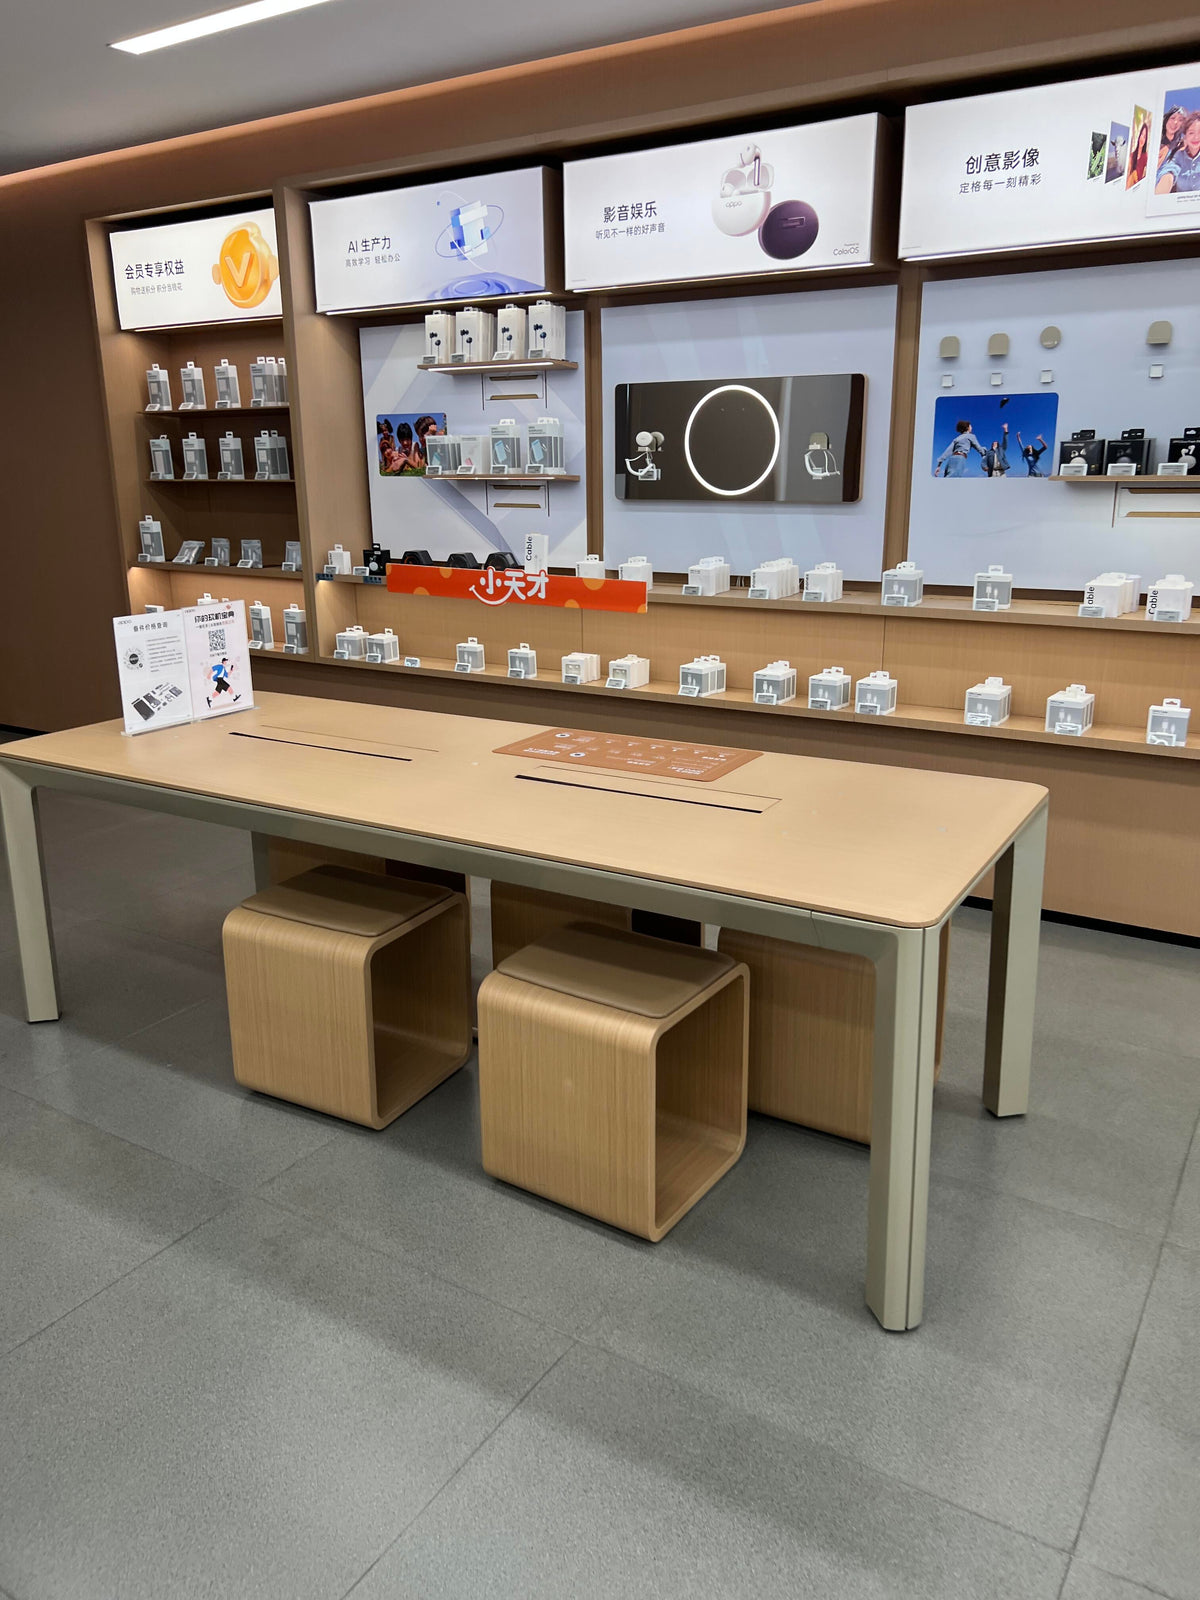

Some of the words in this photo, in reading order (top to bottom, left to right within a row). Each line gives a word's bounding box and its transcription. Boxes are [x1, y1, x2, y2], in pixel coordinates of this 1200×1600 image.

[965, 147, 1040, 175] 创意影像
[958, 173, 1042, 194] 定格每一刻精彩
[603, 200, 657, 223] 影音娱乐
[595, 222, 665, 240] 听见不一样的好声音
[347, 240, 359, 254] AI
[361, 235, 391, 253] 生产力
[833, 246, 859, 256] ColorOS
[374, 253, 401, 264] 轻松办公
[124, 260, 185, 280] 会员专享权益
[525, 536, 533, 561] Cable
[469, 566, 550, 606] 小天才
[1086, 585, 1096, 606] able
[1148, 590, 1159, 615] Cable
